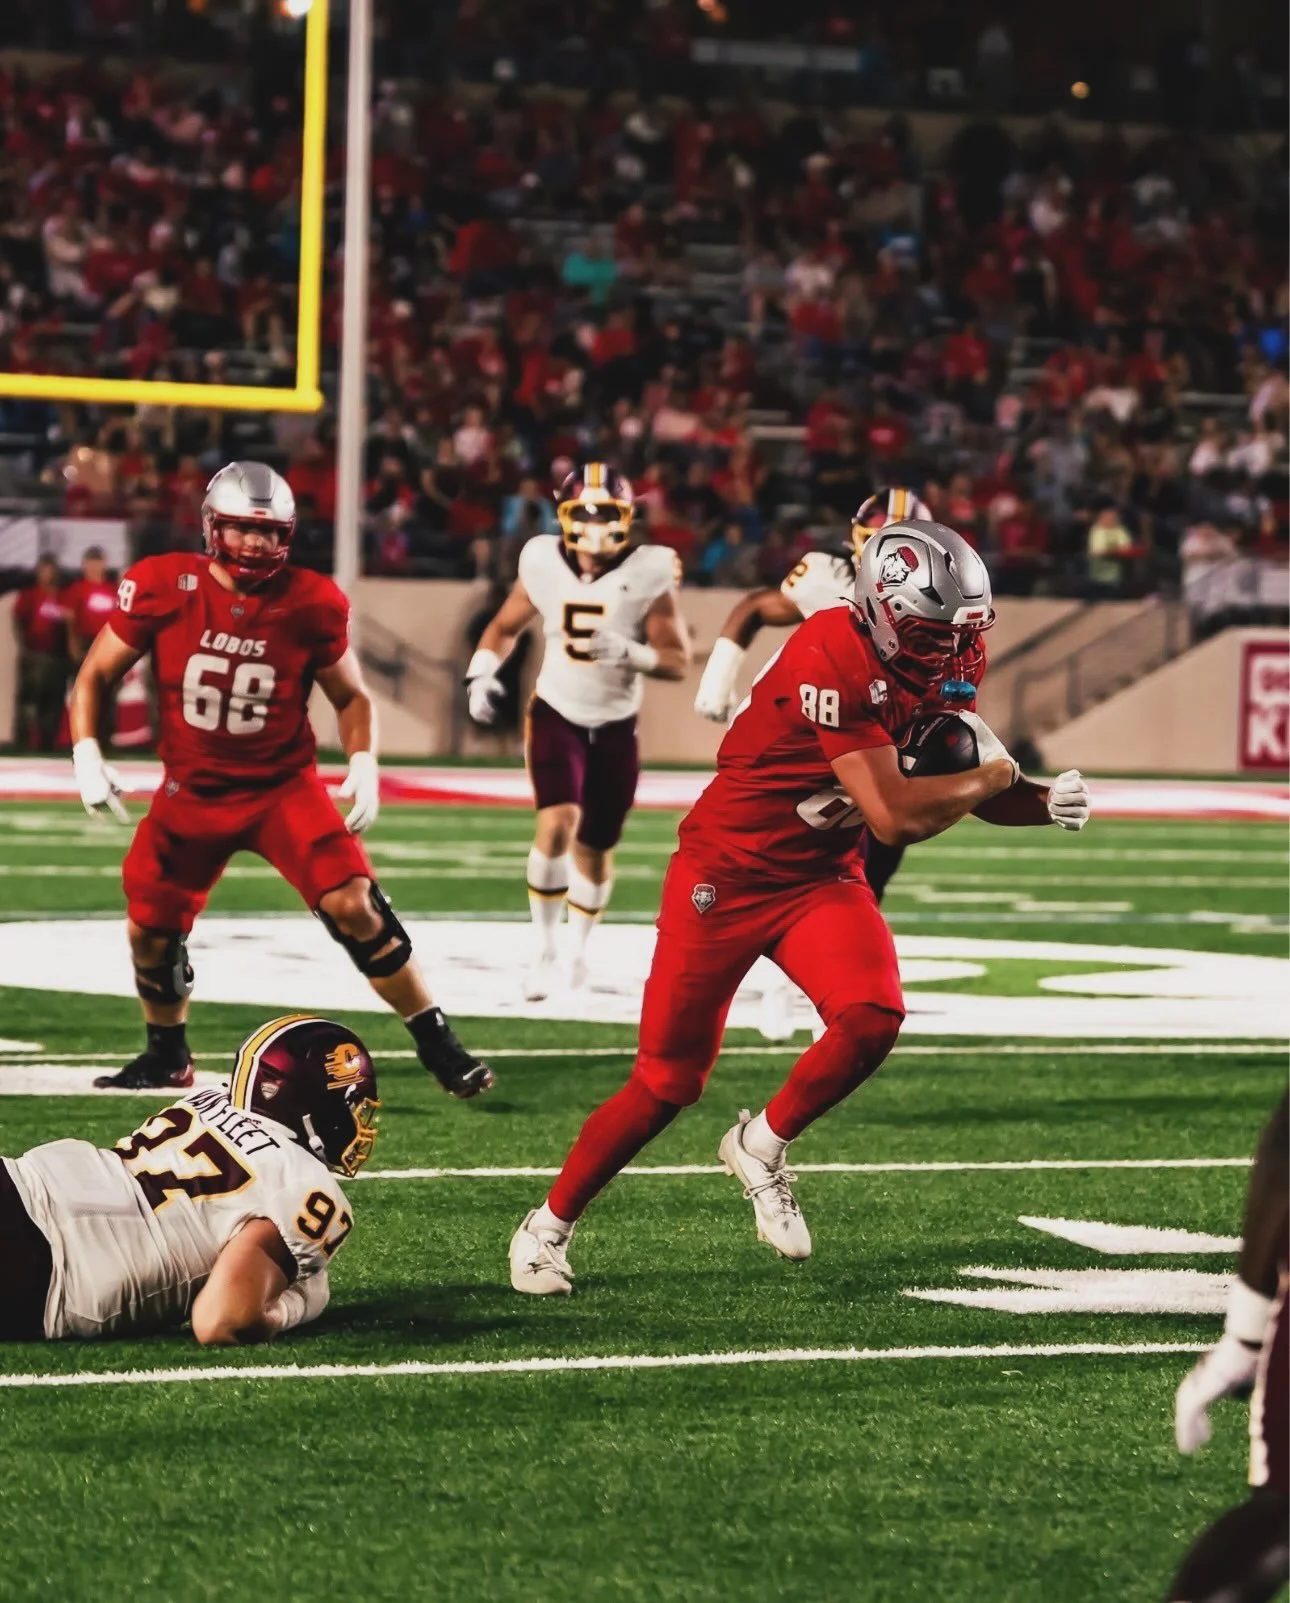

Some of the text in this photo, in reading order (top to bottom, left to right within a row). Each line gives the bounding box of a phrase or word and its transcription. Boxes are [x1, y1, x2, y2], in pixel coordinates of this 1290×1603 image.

[199, 628, 268, 658] LOBOS
[562, 602, 605, 662] 5
[182, 653, 276, 735] 68
[799, 683, 840, 729] 88
[110, 1107, 256, 1216] 97
[296, 1190, 356, 1259] 97
